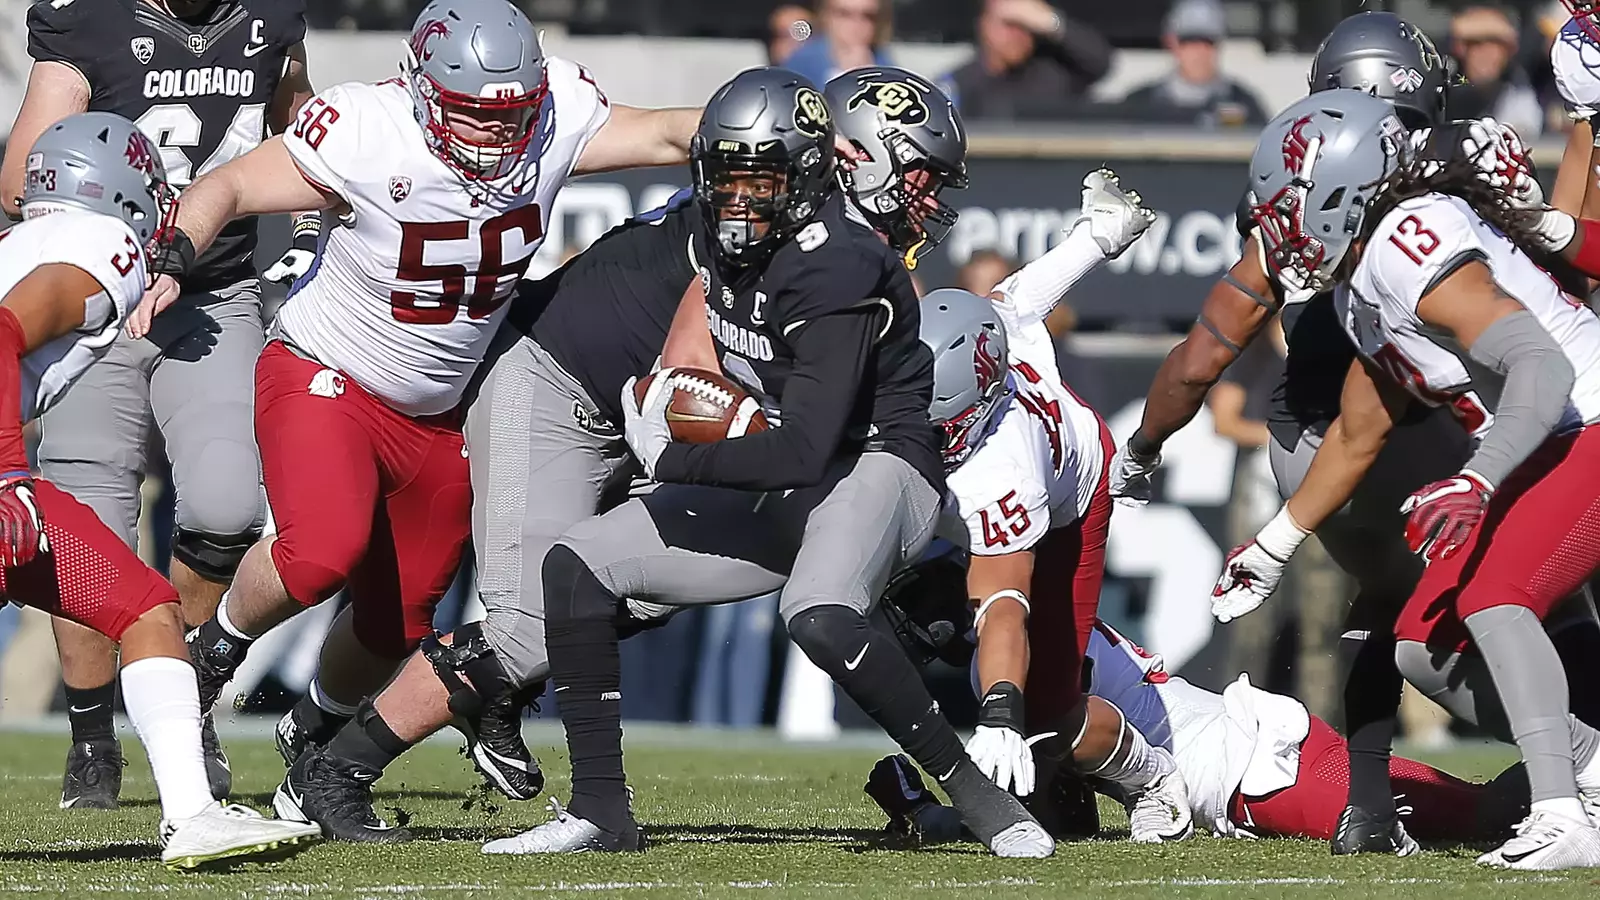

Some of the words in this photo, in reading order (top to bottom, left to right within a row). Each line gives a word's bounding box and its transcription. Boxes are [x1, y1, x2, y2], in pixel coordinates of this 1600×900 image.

[251, 19, 264, 44] C
[142, 66, 255, 98] COLORADO
[876, 82, 914, 117] CU
[294, 97, 340, 151] 56
[45, 169, 56, 191] 3
[110, 233, 139, 277] 3
[1389, 214, 1441, 267] 13
[391, 202, 543, 324] 56
[979, 489, 1031, 548] 45
